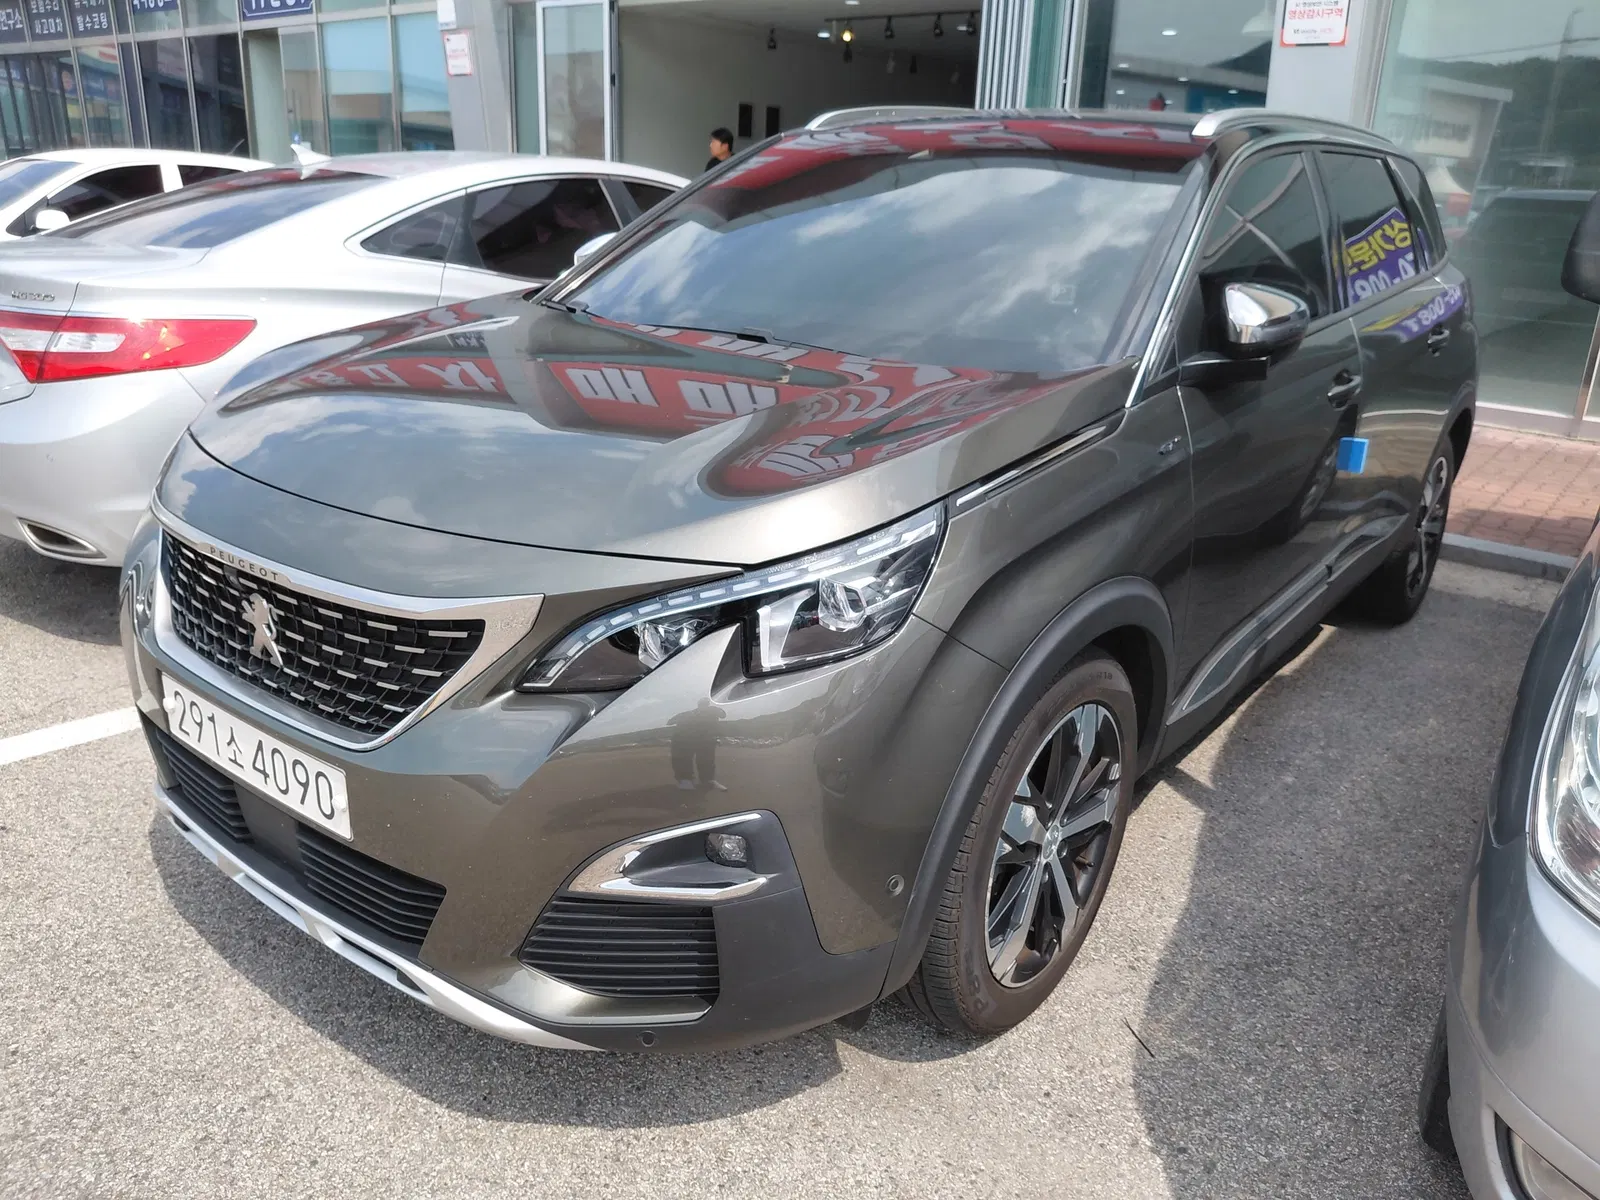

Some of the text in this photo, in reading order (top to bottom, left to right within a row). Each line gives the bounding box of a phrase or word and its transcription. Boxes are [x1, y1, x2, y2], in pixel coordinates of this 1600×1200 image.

[76, 12, 108, 31] 발수코팅
[1288, 8, 1343, 20] 영상감시구역
[210, 546, 279, 581] PEUGEOT
